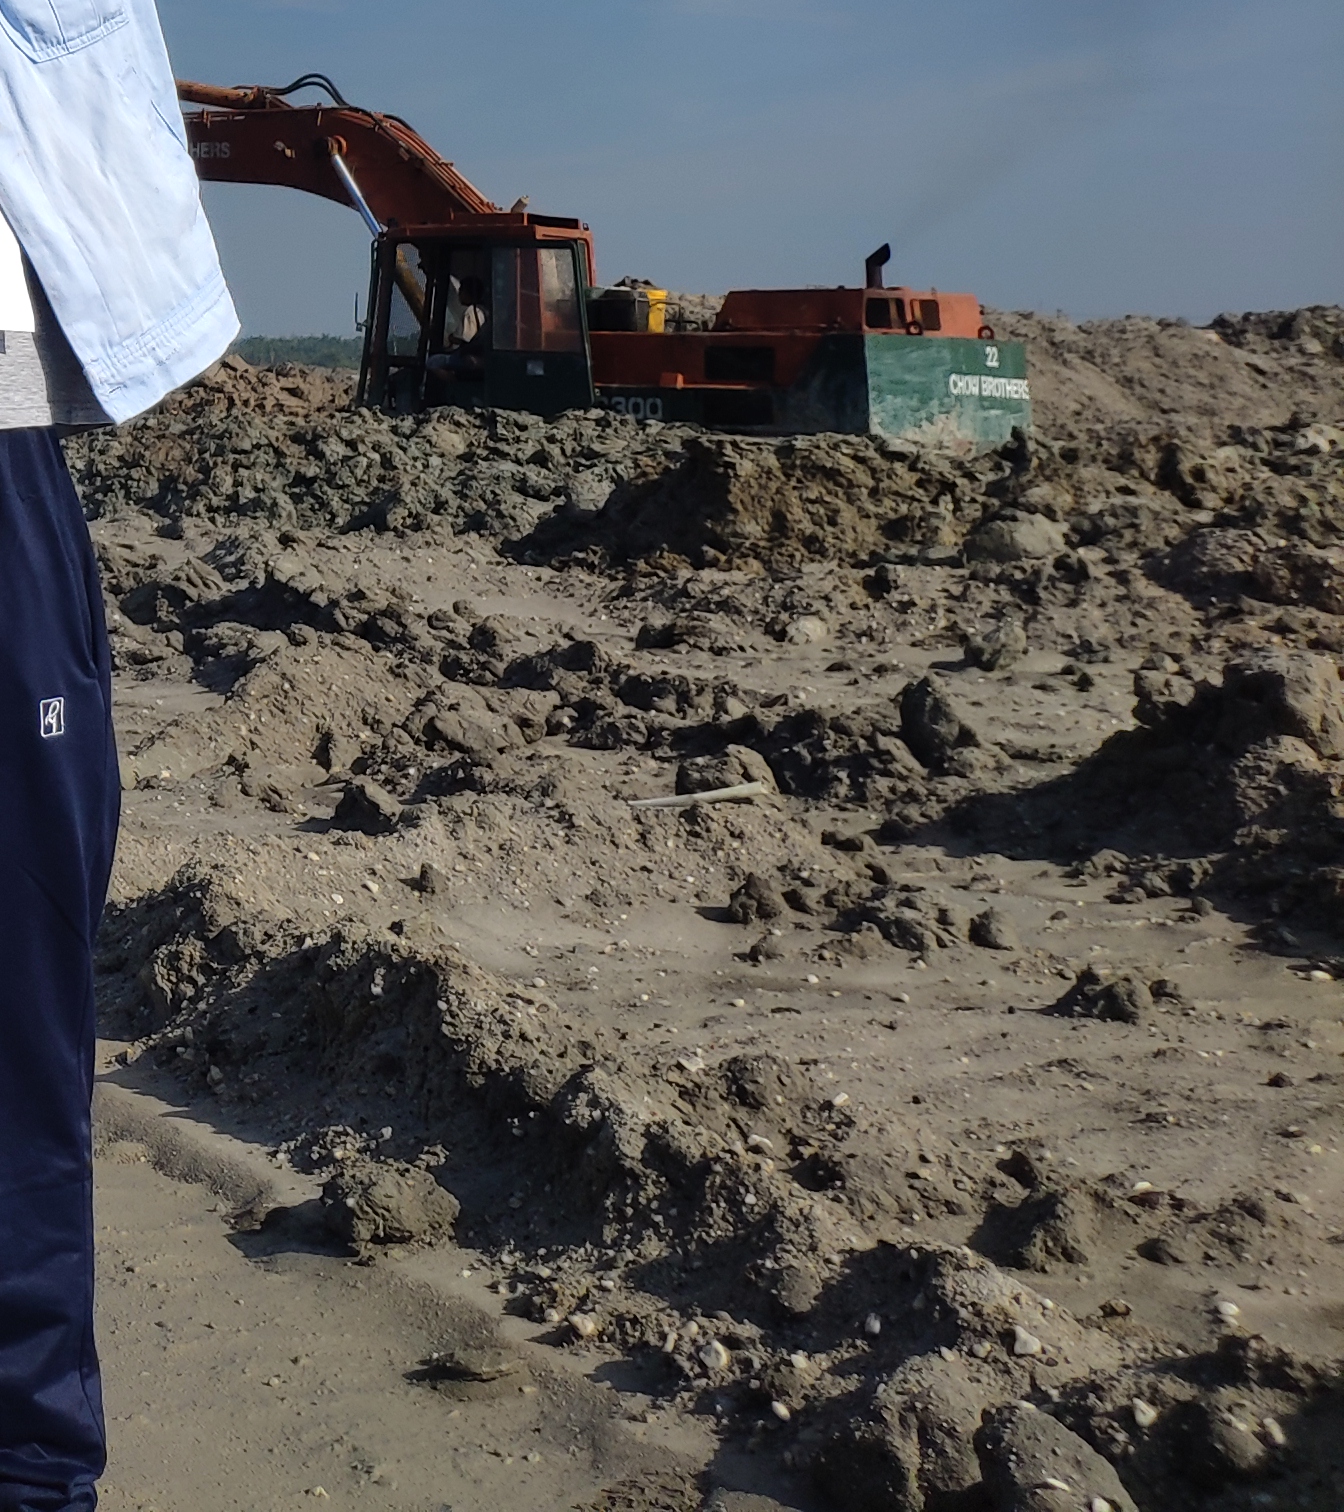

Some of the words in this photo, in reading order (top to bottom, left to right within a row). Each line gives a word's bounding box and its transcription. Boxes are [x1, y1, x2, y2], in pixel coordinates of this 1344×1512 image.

[985, 346, 1000, 368] 22
[949, 373, 979, 396] CHOW
[981, 375, 1030, 400] BROTHERS
